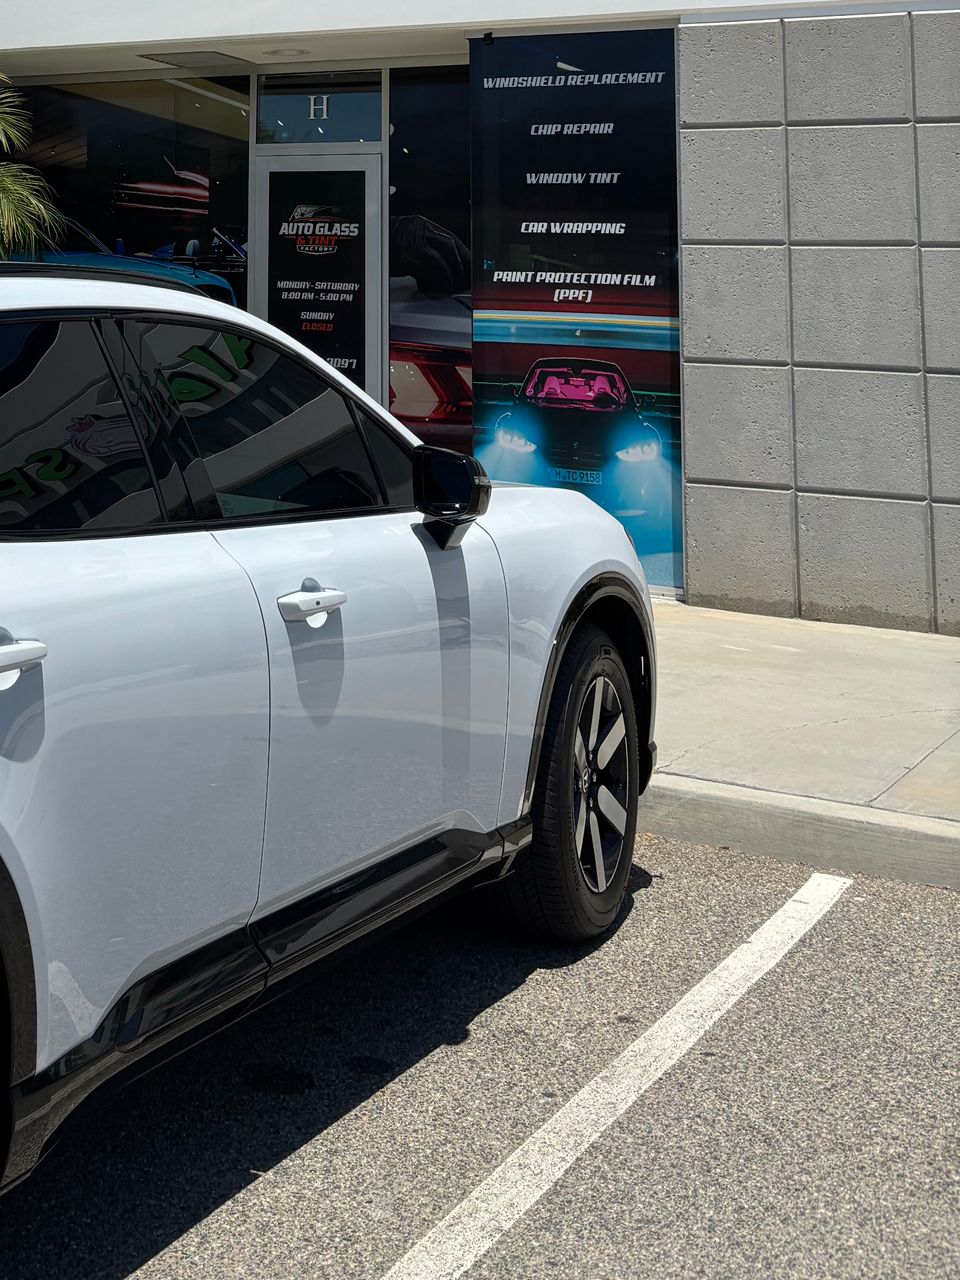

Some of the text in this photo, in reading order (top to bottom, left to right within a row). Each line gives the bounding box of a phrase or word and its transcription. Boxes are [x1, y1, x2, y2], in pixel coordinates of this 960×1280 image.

[483, 72, 666, 89] WINDSHIELD REPLACEMENT
[308, 95, 330, 120] H
[530, 123, 615, 136] CHIP REPAIR
[526, 172, 621, 184] WINDOW TINT
[279, 222, 360, 236] AUTO GLASS
[520, 222, 626, 234] CAR WRAPPING
[308, 236, 337, 246] TINT
[493, 271, 656, 287] PAINT PROTECTION FILM
[281, 292, 301, 300] 8:00
[301, 292, 314, 300] AM
[319, 293, 339, 301] 5:00
[300, 312, 335, 320] SUNDAY
[302, 322, 333, 331] CLOSED
